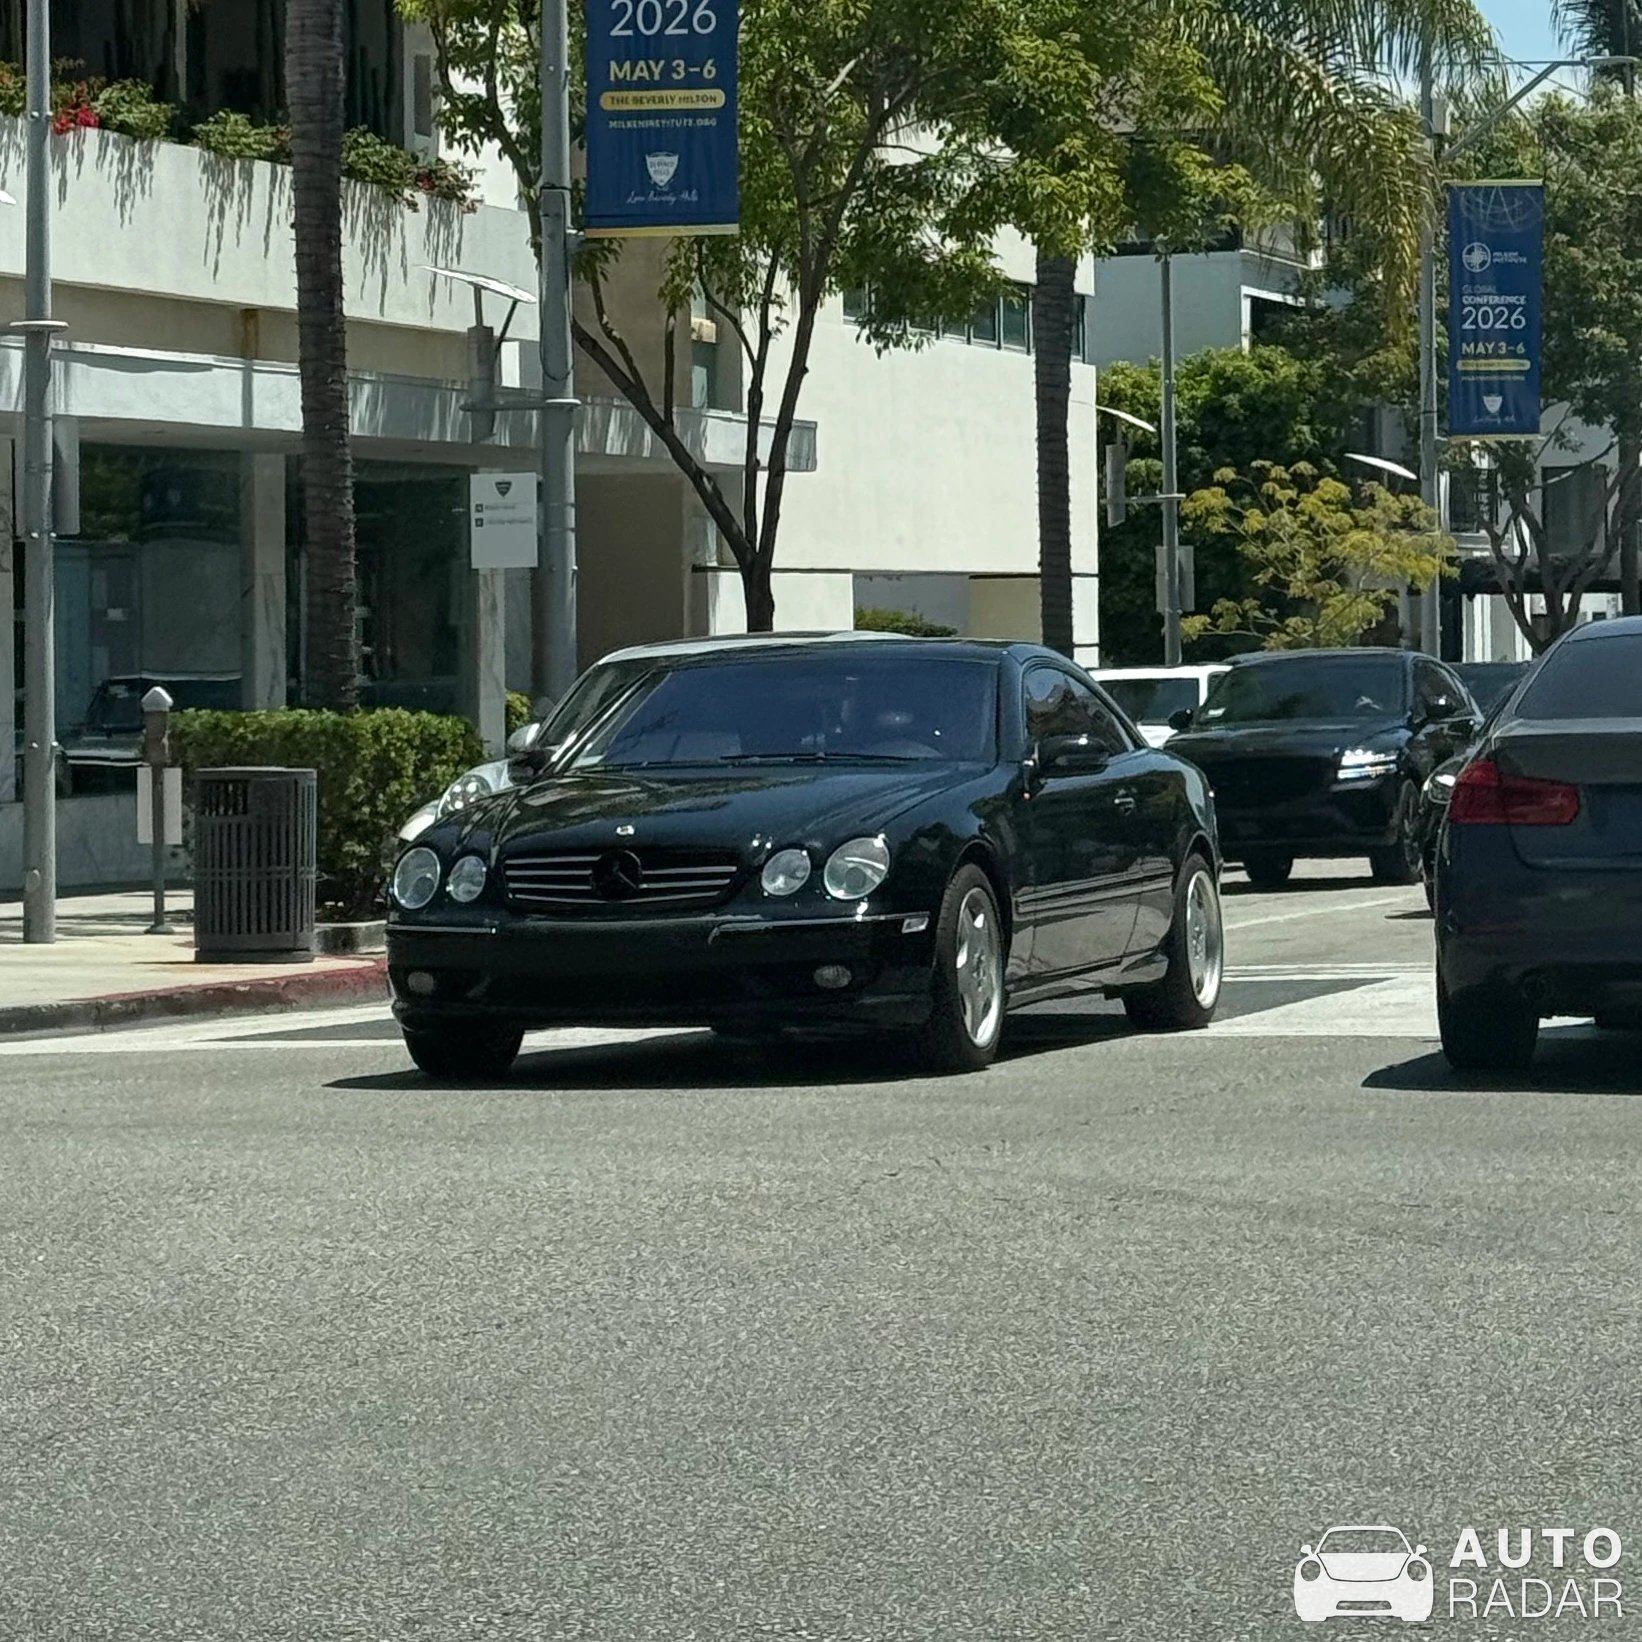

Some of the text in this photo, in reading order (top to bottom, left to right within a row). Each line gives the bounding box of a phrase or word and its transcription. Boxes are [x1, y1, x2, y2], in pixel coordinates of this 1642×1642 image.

[609, 0, 717, 36] 2026
[609, 59, 665, 81] MAY
[610, 92, 717, 106] THE BEVERLY HILTON
[1462, 295, 1526, 305] CONFERENCE
[1461, 306, 1526, 329] 2026
[1461, 341, 1495, 354] MAY
